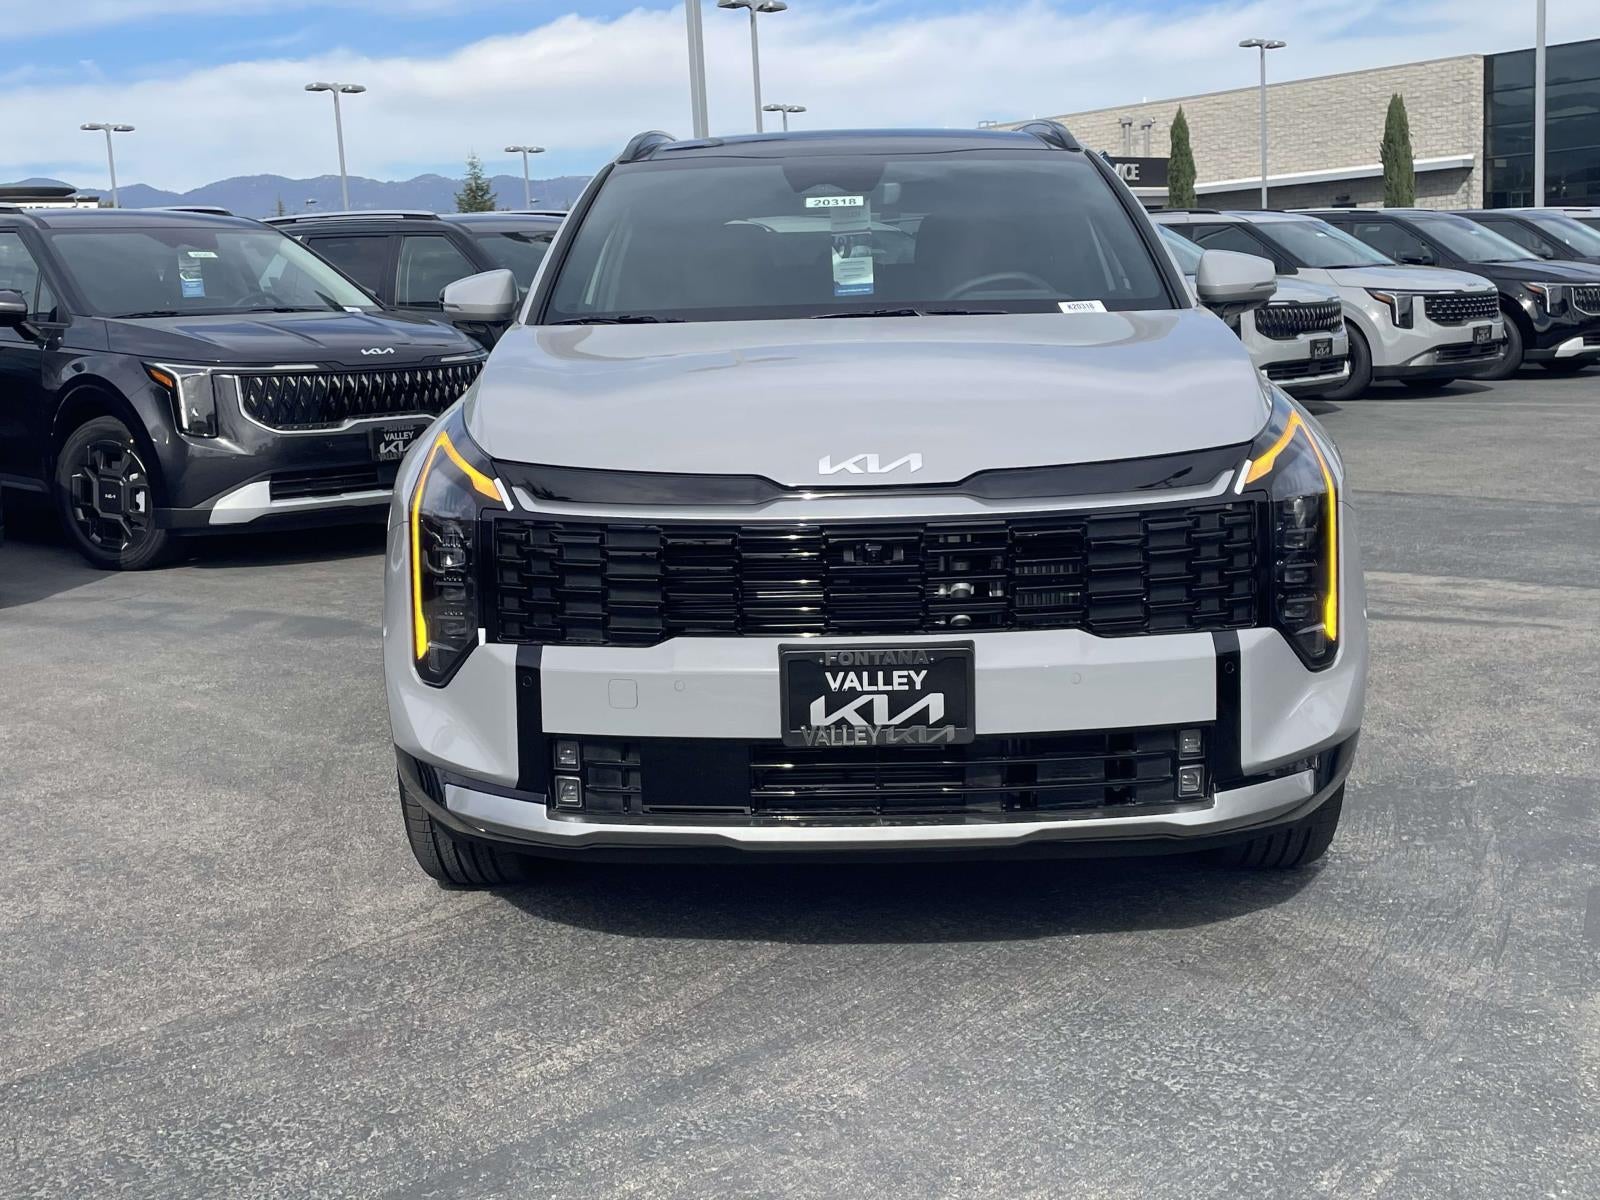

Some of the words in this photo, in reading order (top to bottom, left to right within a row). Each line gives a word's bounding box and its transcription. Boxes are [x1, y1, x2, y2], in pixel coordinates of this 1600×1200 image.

[361, 347, 395, 355] KIA
[384, 431, 414, 441] VALLEY
[818, 452, 923, 475] KIA
[824, 651, 930, 667] FONTANA
[824, 669, 928, 692] VALLEY
[810, 693, 945, 726] KIA
[801, 724, 883, 747] VALLEY
[885, 724, 956, 745] KIA
